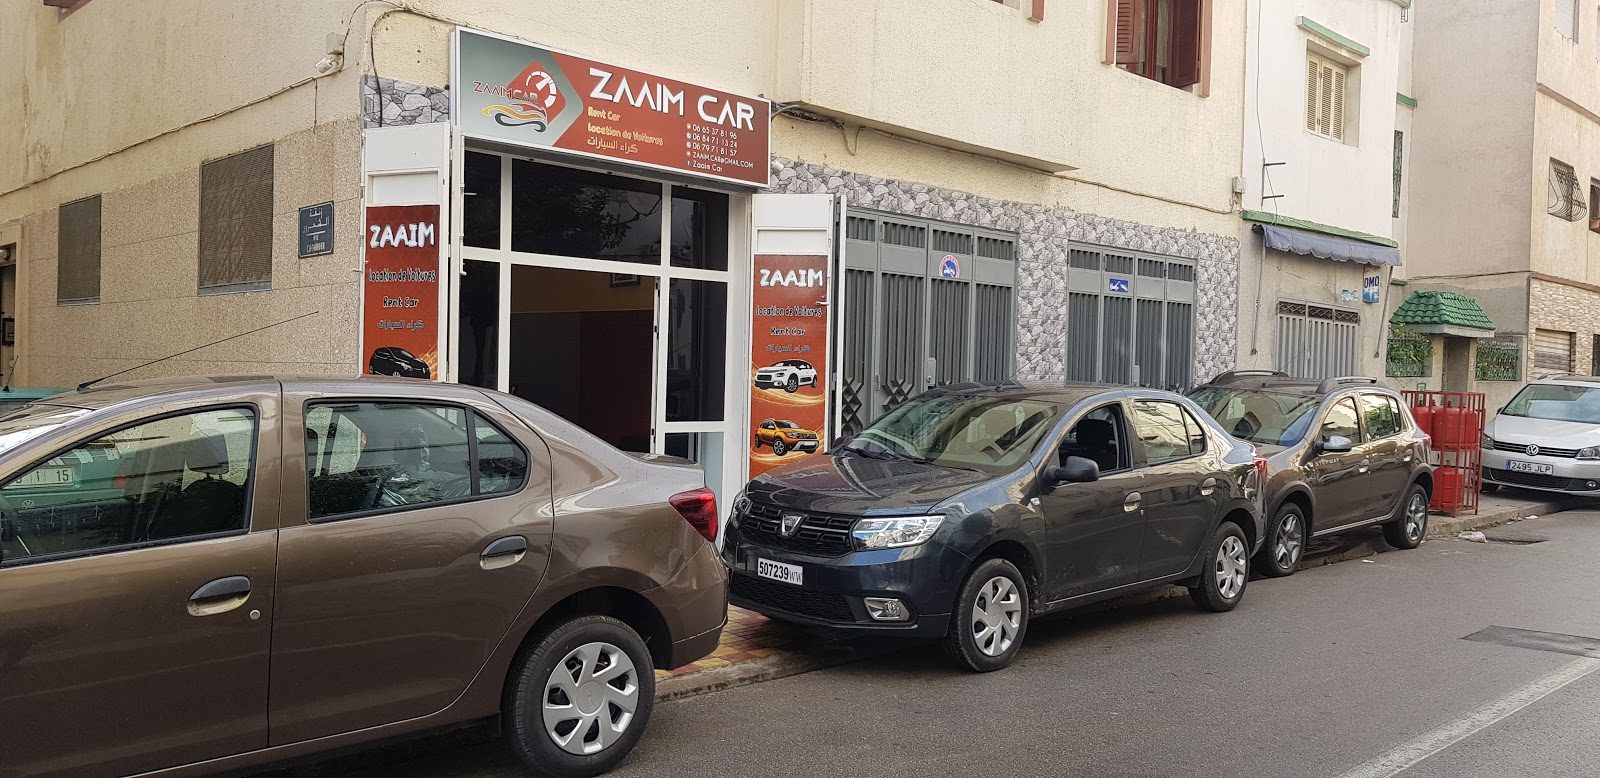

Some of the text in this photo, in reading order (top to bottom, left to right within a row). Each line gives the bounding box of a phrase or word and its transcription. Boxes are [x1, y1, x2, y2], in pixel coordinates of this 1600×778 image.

[589, 67, 755, 131] ZAAIM CAR
[587, 106, 621, 122] Rent Car
[587, 122, 664, 146] Location de Voitures
[692, 124, 701, 132] 06
[702, 126, 710, 134] 65
[729, 132, 737, 140] 96
[692, 133, 701, 141] 06
[587, 137, 618, 150] السيارات
[692, 142, 701, 150] 06
[693, 161, 722, 172] Zaaim Car
[370, 222, 435, 248] ZAAIM
[397, 268, 406, 282] de
[407, 267, 436, 282] Voitures
[759, 268, 823, 288] ZAAIM
[1364, 276, 1380, 289] OMO
[383, 295, 420, 308] Rent Car
[785, 305, 793, 316] de
[794, 305, 822, 317] Voitures
[791, 327, 806, 336] Car
[1511, 462, 1532, 471] 2495
[56, 469, 69, 482] 15
